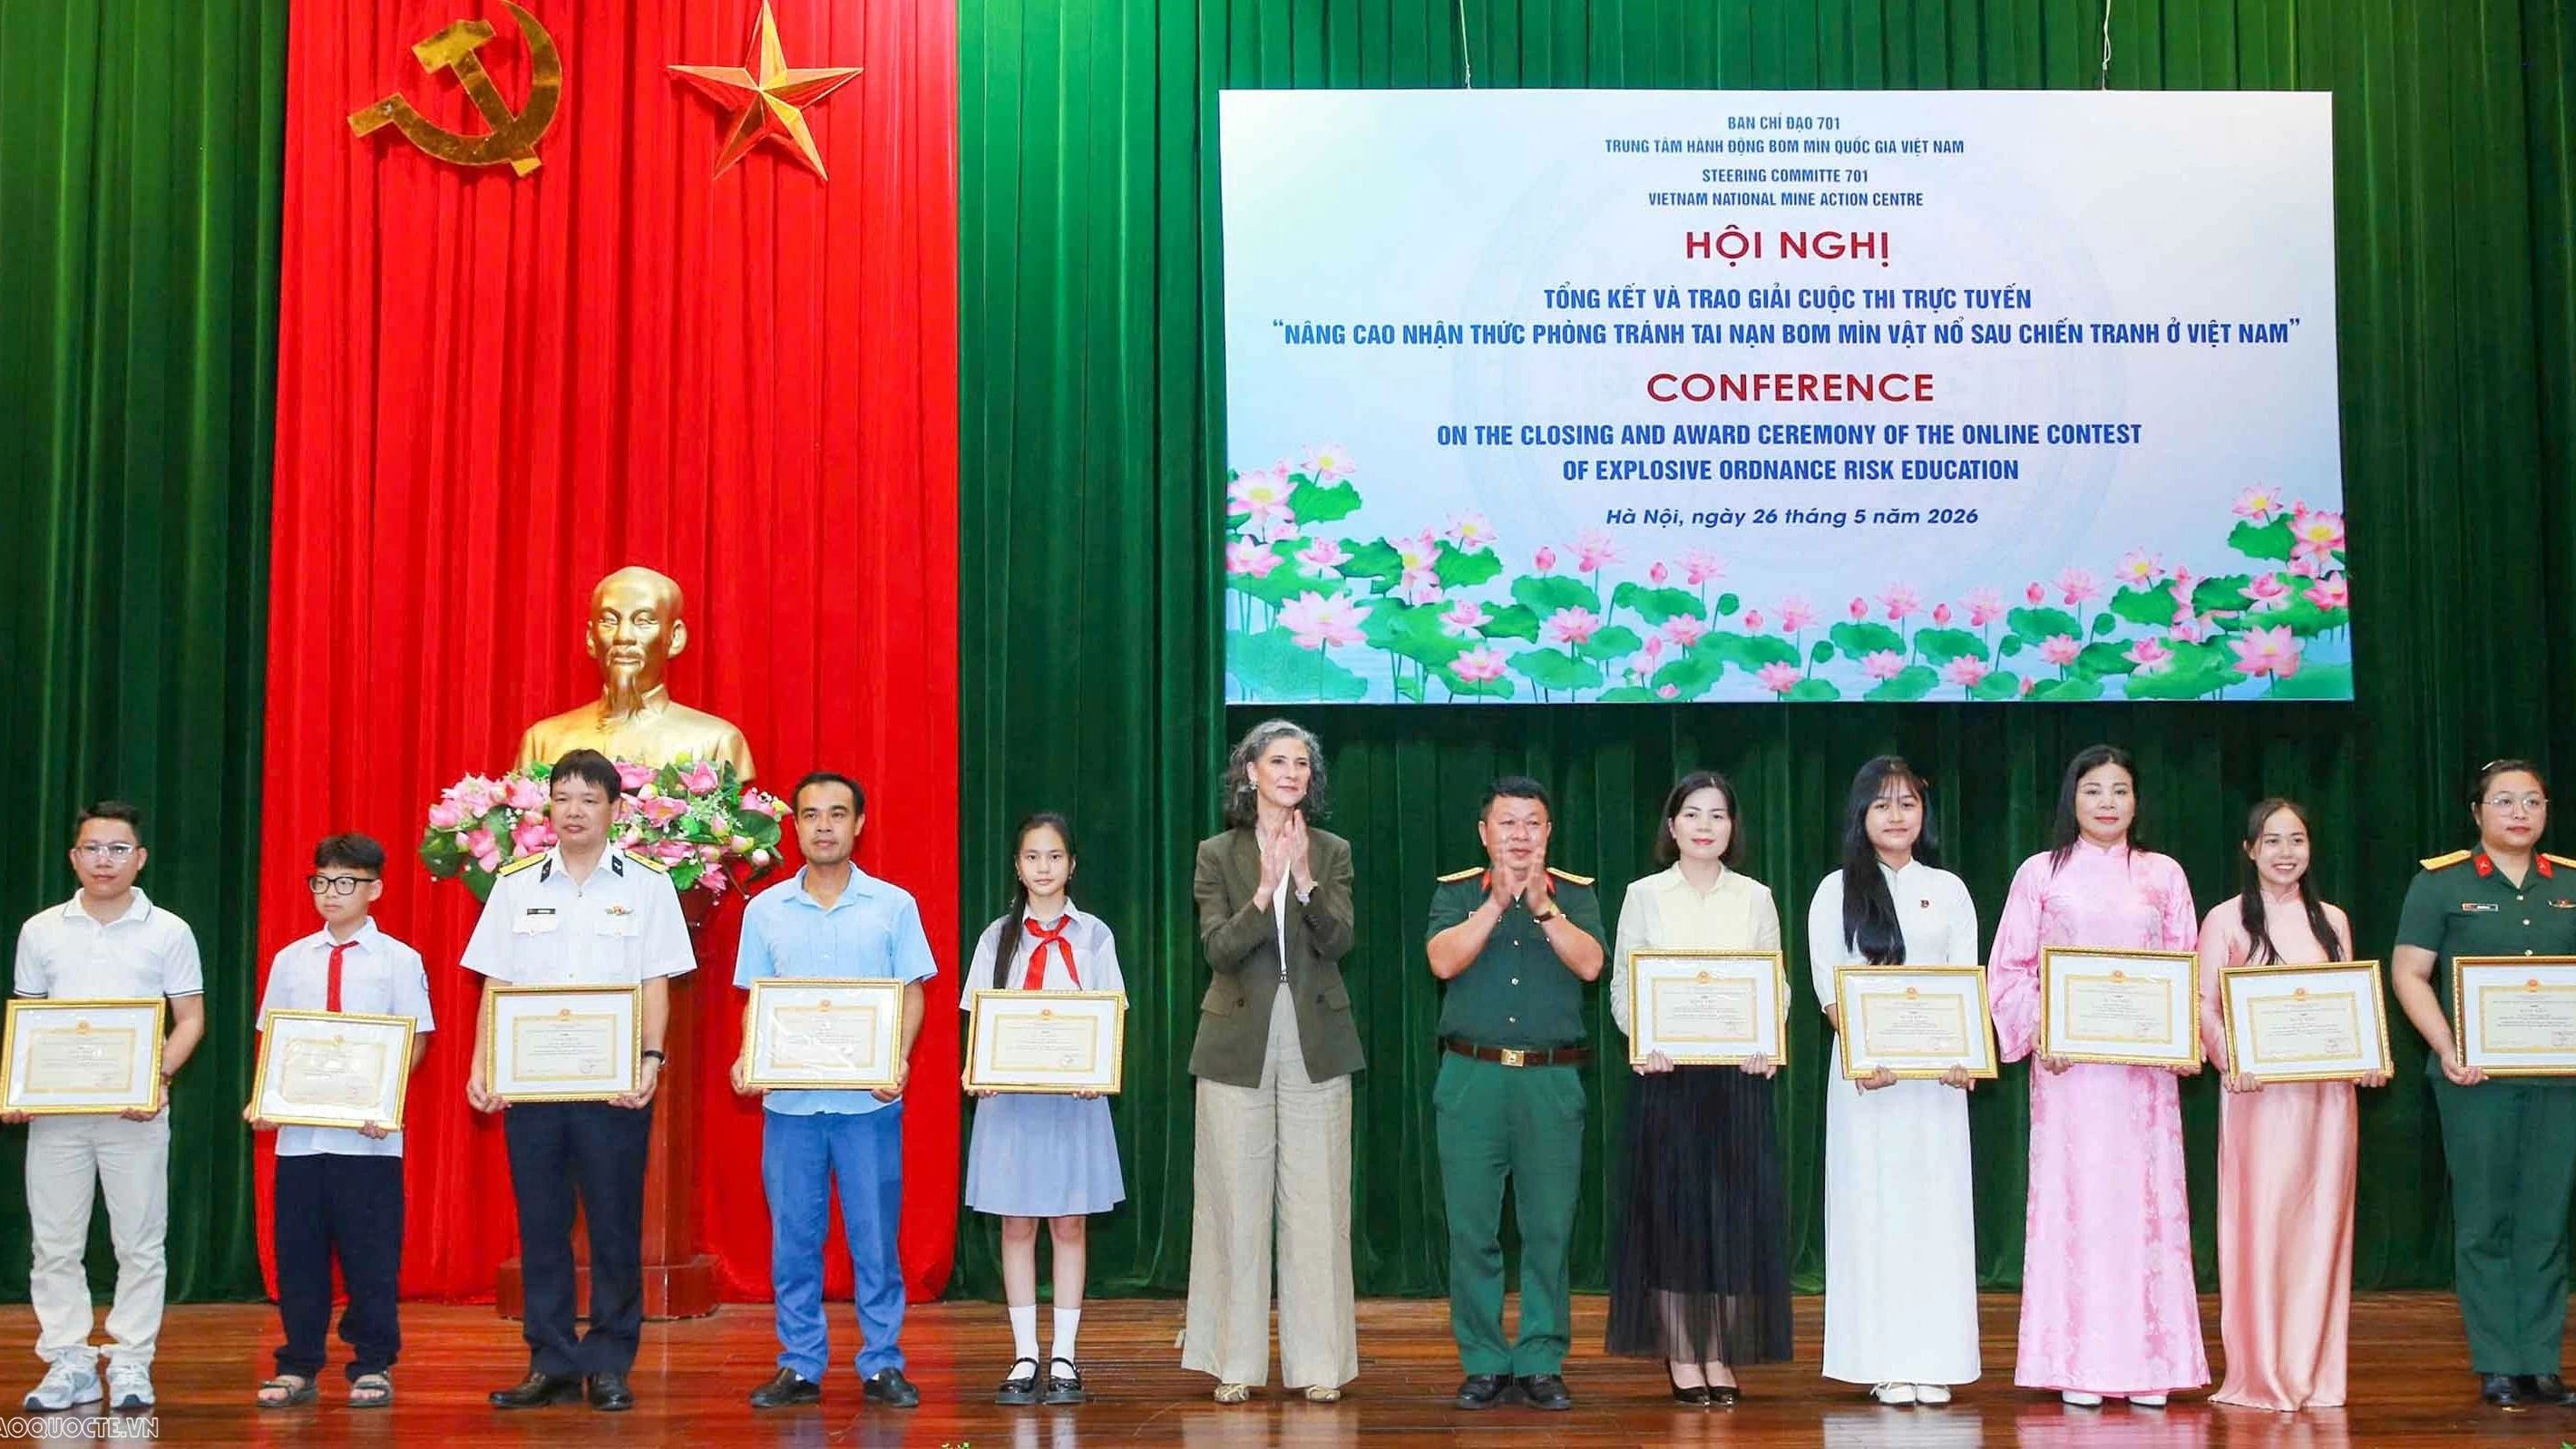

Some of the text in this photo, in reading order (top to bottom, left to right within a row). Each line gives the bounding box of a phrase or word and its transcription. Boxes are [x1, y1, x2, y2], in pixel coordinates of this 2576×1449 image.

[1728, 116, 1756, 131] BAN
[1786, 116, 1813, 133] ĐẠO
[1817, 116, 1840, 131] 701
[1605, 139, 1650, 153] TRUNG
[1654, 136, 1683, 153] TÂM
[1686, 136, 1723, 153] HÀNH
[1727, 136, 1765, 157] ĐỘNG
[1769, 139, 1800, 153] BOM
[1834, 134, 1870, 155] QUỐC
[1874, 140, 1898, 154] GIA
[1900, 136, 1929, 157] VIỆT
[1933, 140, 1965, 153] NAM
[1702, 169, 1869, 183] STEERING COMMITTE 701
[1648, 191, 1924, 207] VIETNAM NATIONAL MINE ACTION CENTRE
[1686, 224, 1889, 268] HỘI NGHỊ
[1543, 281, 2032, 314] TỔNG KẾT VÀ TRAO GIẢI CUỘC THI TRỰC TUYẾN
[1352, 324, 1396, 345] CAO
[1402, 320, 1464, 349] NHẬN
[1469, 319, 1526, 345] THỨC
[1532, 319, 1606, 345] PHÒNG
[1613, 319, 1684, 345] TRÁNH
[1691, 324, 1722, 345] TAI
[1729, 324, 1775, 349] NẠN
[1781, 323, 1831, 345] BOM
[1838, 319, 1881, 345] MÌN
[1888, 319, 1927, 349] VẬT
[1934, 316, 1965, 345] NỔ
[1971, 323, 2012, 345] SAU
[2018, 316, 2083, 345] CHIẾN
[2089, 323, 2160, 344] TRANH
[2166, 316, 2181, 344] Ở
[2186, 319, 2232, 348] VIỆT
[1646, 373, 1934, 403] CONFERENCE
[1437, 423, 2142, 446] ON THE CLOSING AND AWARD CEREMONY OF THE ONLINE CONTEST
[1563, 459, 2019, 481] OF EXPLOSIVE ORDNANCE RISK EDUCATION
[1605, 507, 1979, 530] Hà Nội, ngày 26 tháng 5 năm 2026
